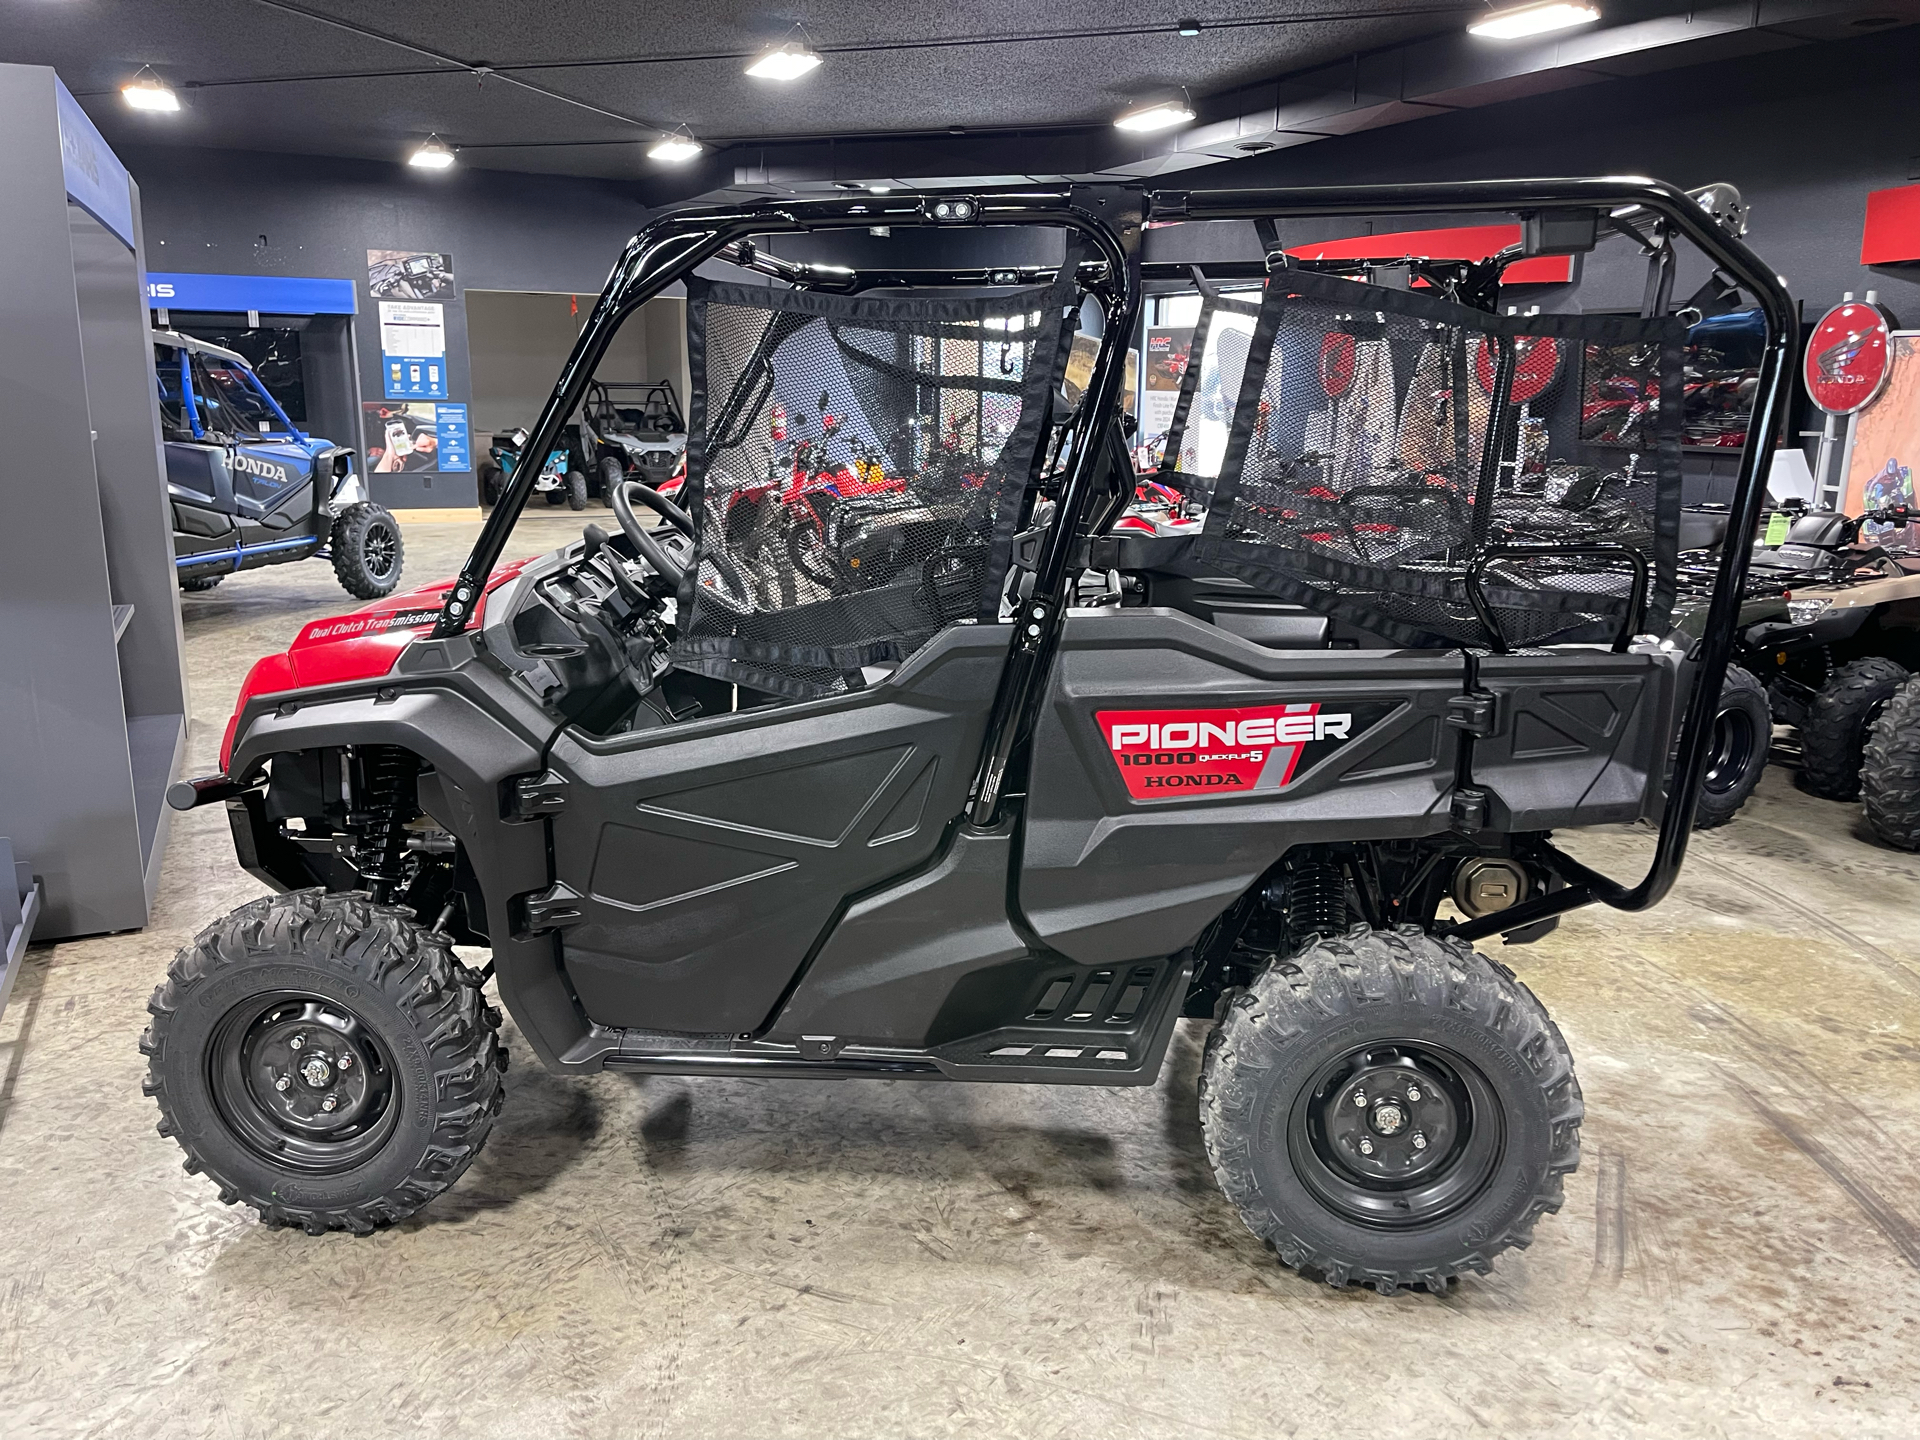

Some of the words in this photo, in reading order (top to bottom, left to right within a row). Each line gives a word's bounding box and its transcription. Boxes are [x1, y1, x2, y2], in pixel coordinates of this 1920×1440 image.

[221, 447, 288, 483] HONDA
[252, 477, 283, 489] TALON
[308, 626, 333, 640] Dual
[332, 620, 364, 636] Clutch
[365, 611, 440, 631] Transmission
[1111, 713, 1352, 750] PIONEER
[1120, 752, 1196, 767] 1000
[1144, 773, 1244, 788] HONDA
